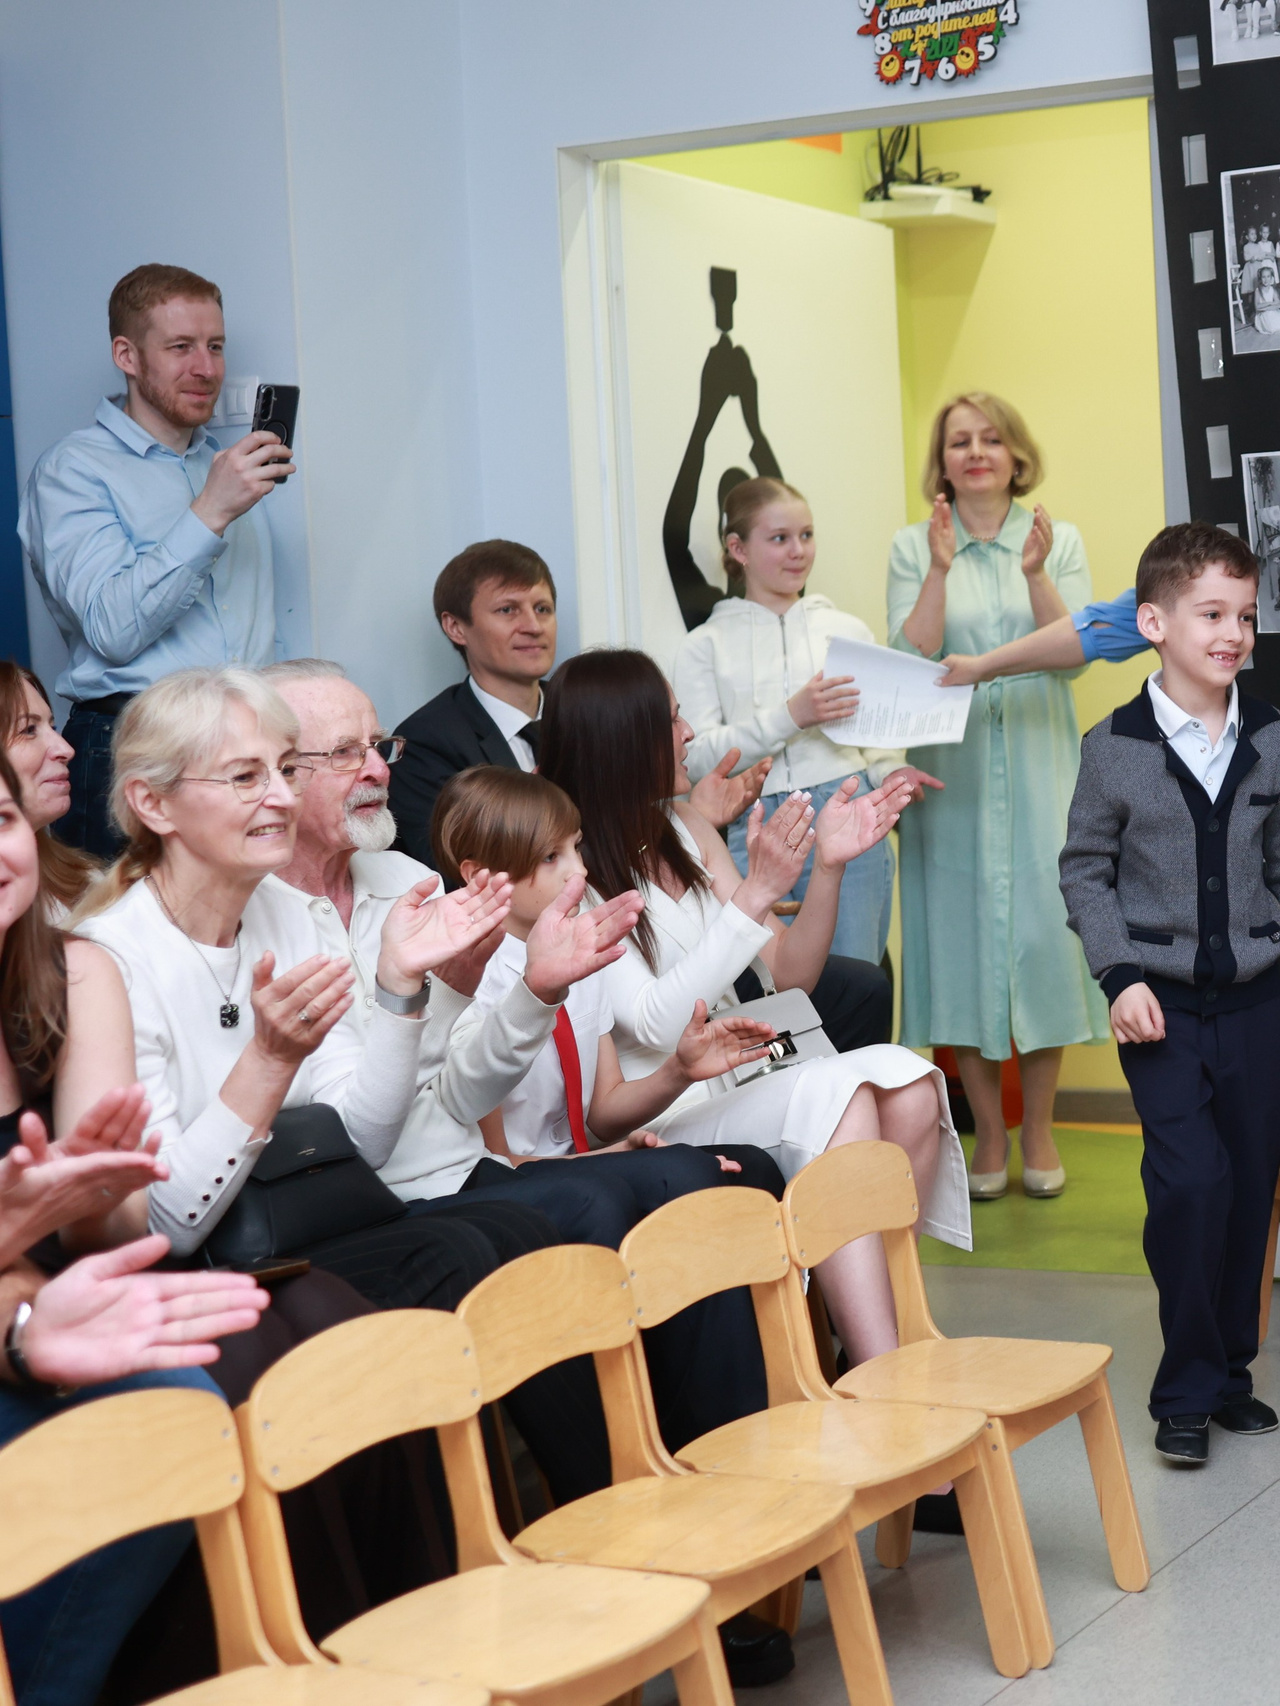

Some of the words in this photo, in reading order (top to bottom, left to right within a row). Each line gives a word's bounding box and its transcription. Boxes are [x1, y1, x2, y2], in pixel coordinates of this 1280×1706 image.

[999, 0, 1017, 24] 4
[890, 28, 914, 43] от
[914, 7, 998, 42] родителей
[875, 32, 892, 55] 8
[977, 34, 996, 61] 5
[904, 59, 921, 84] 7
[938, 56, 956, 80] 6
